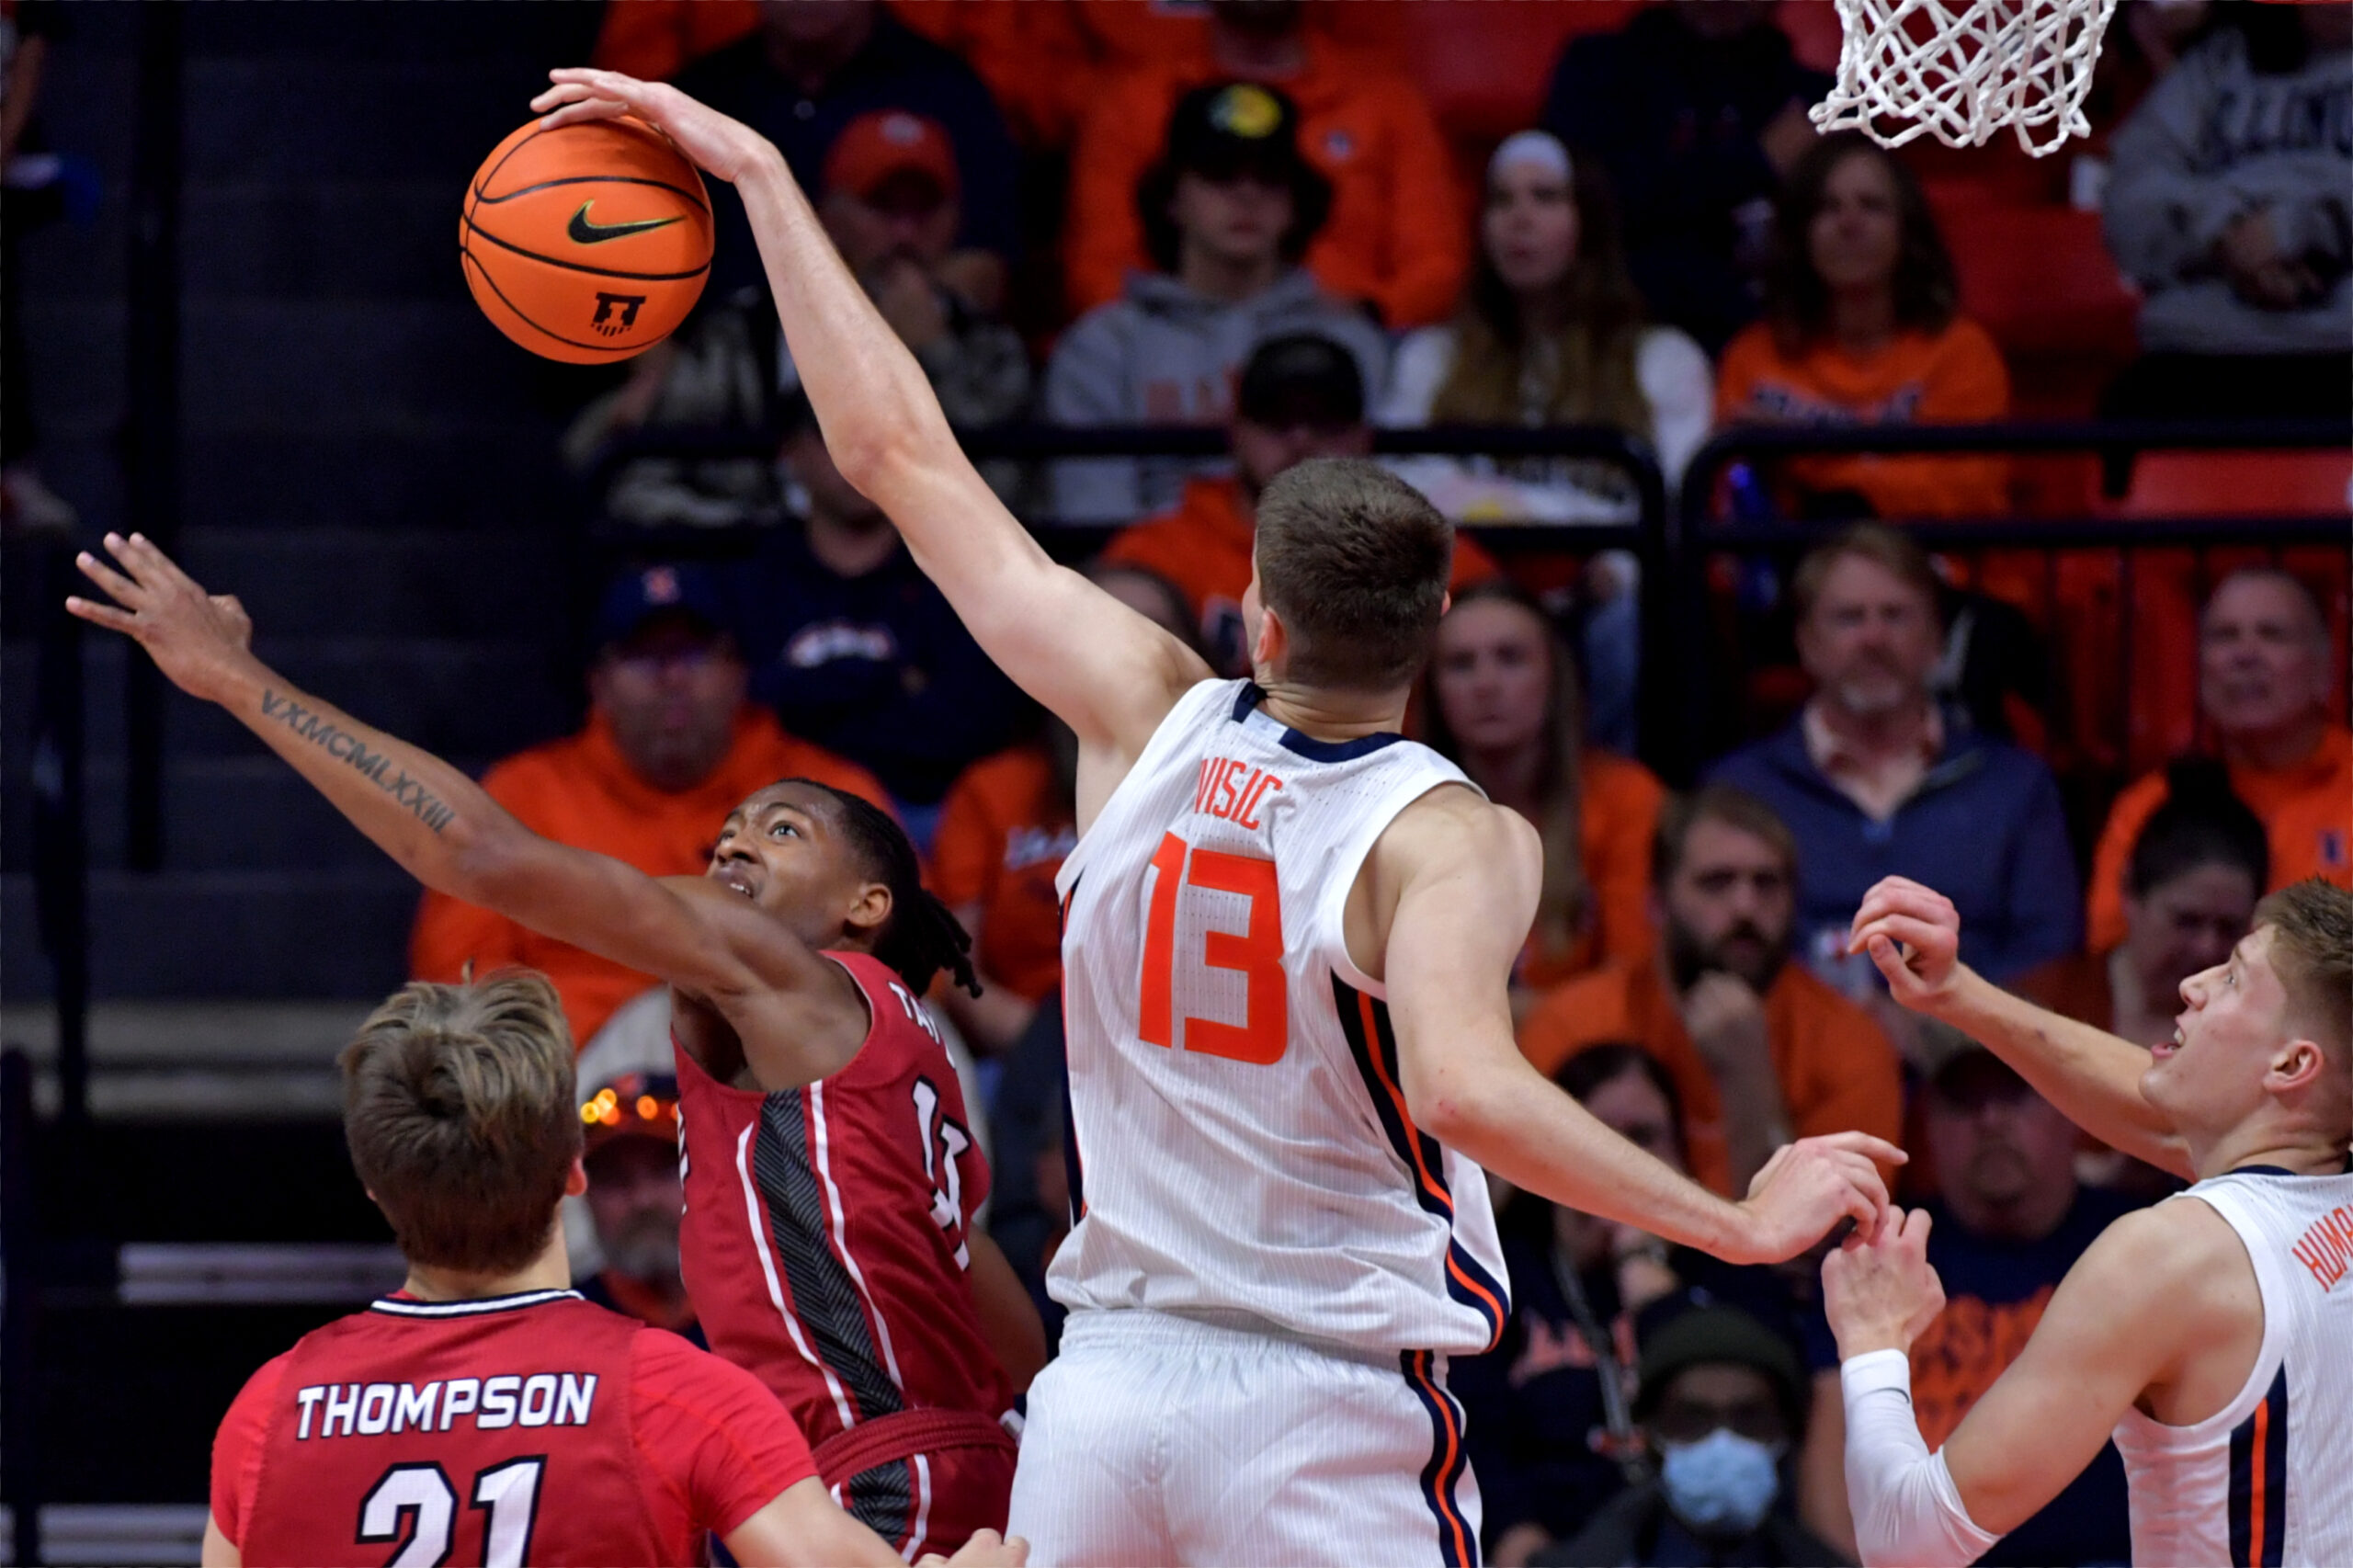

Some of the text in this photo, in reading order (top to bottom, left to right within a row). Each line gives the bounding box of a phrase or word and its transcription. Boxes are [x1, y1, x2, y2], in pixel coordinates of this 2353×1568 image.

[1194, 756, 1283, 830] VISIC
[1139, 830, 1288, 1065] 13
[296, 1371, 599, 1440] THOMPSON
[355, 1454, 549, 1568] 21
